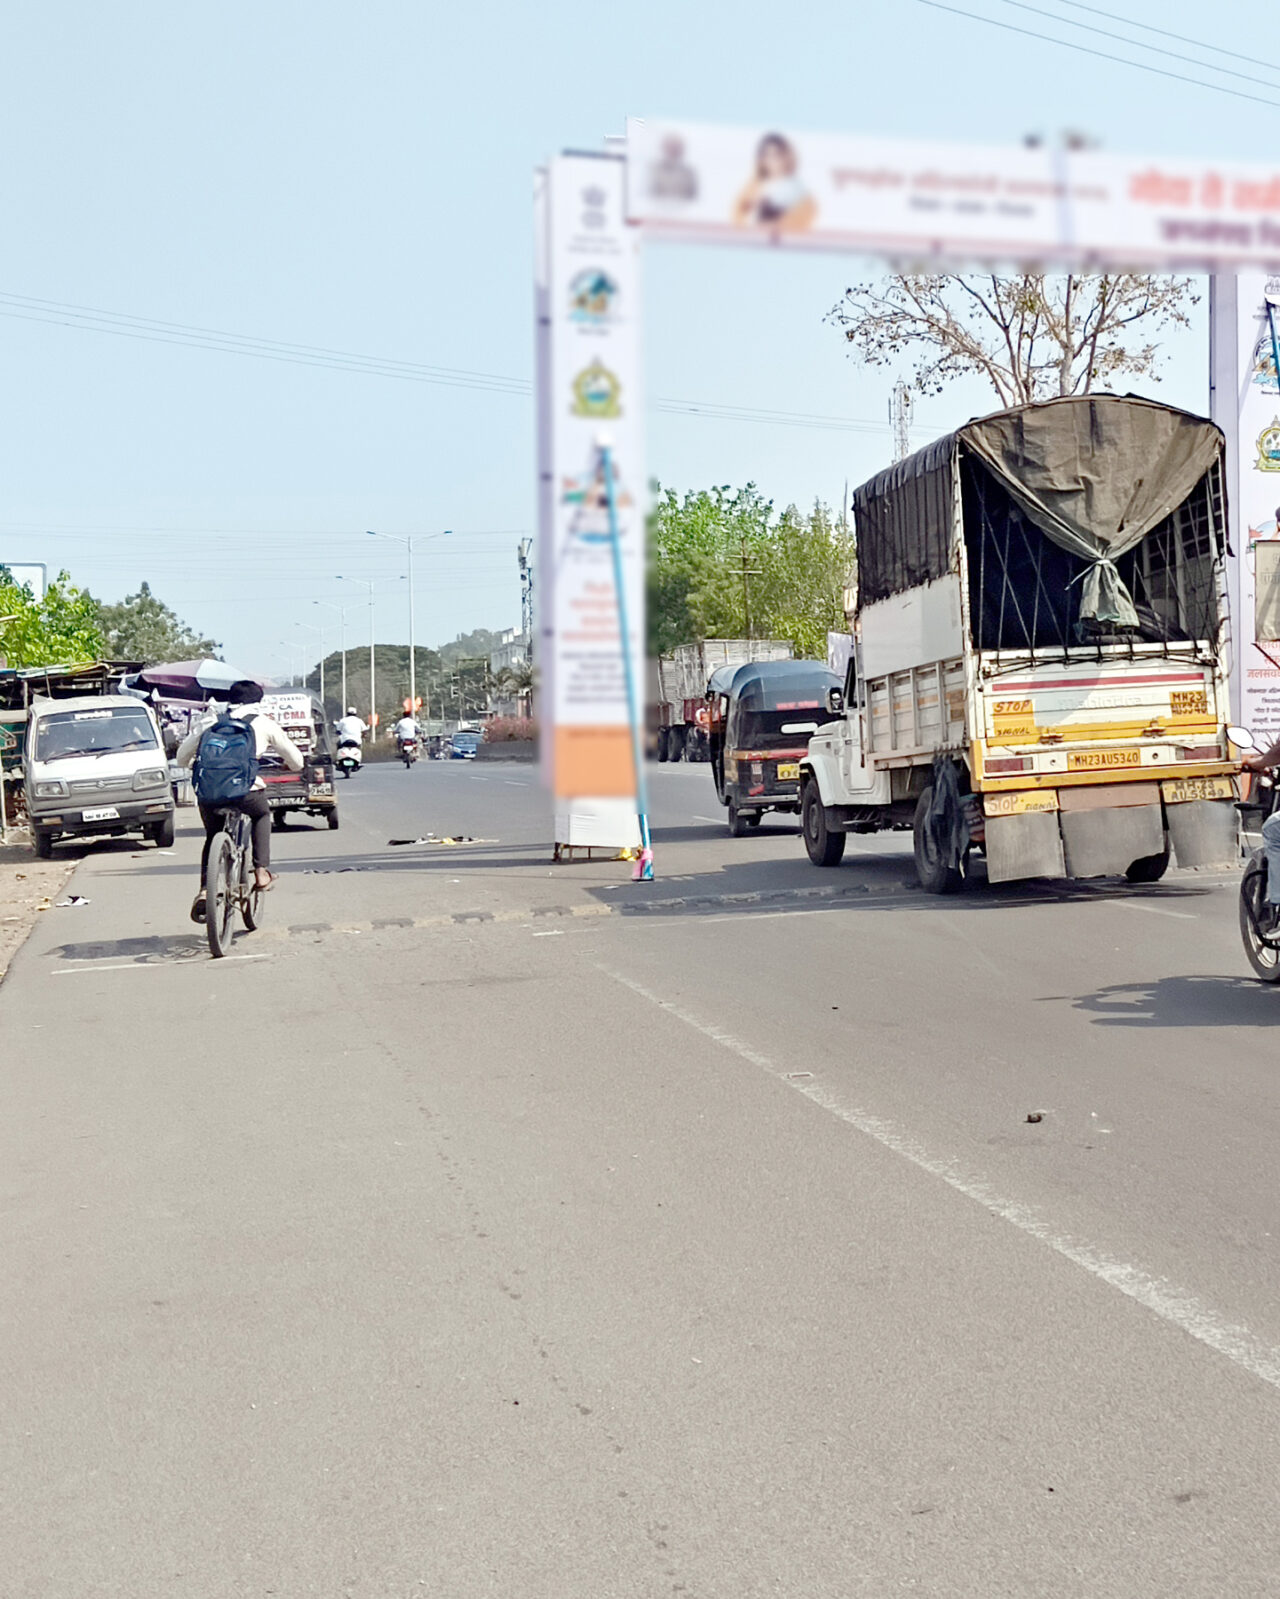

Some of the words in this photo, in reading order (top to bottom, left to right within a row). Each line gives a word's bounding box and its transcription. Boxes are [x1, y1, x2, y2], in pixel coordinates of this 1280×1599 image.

[1172, 692, 1204, 703] MH23
[994, 699, 1032, 713] STOP
[283, 711, 306, 721] CMA
[1074, 752, 1140, 767] MH23AU5340
